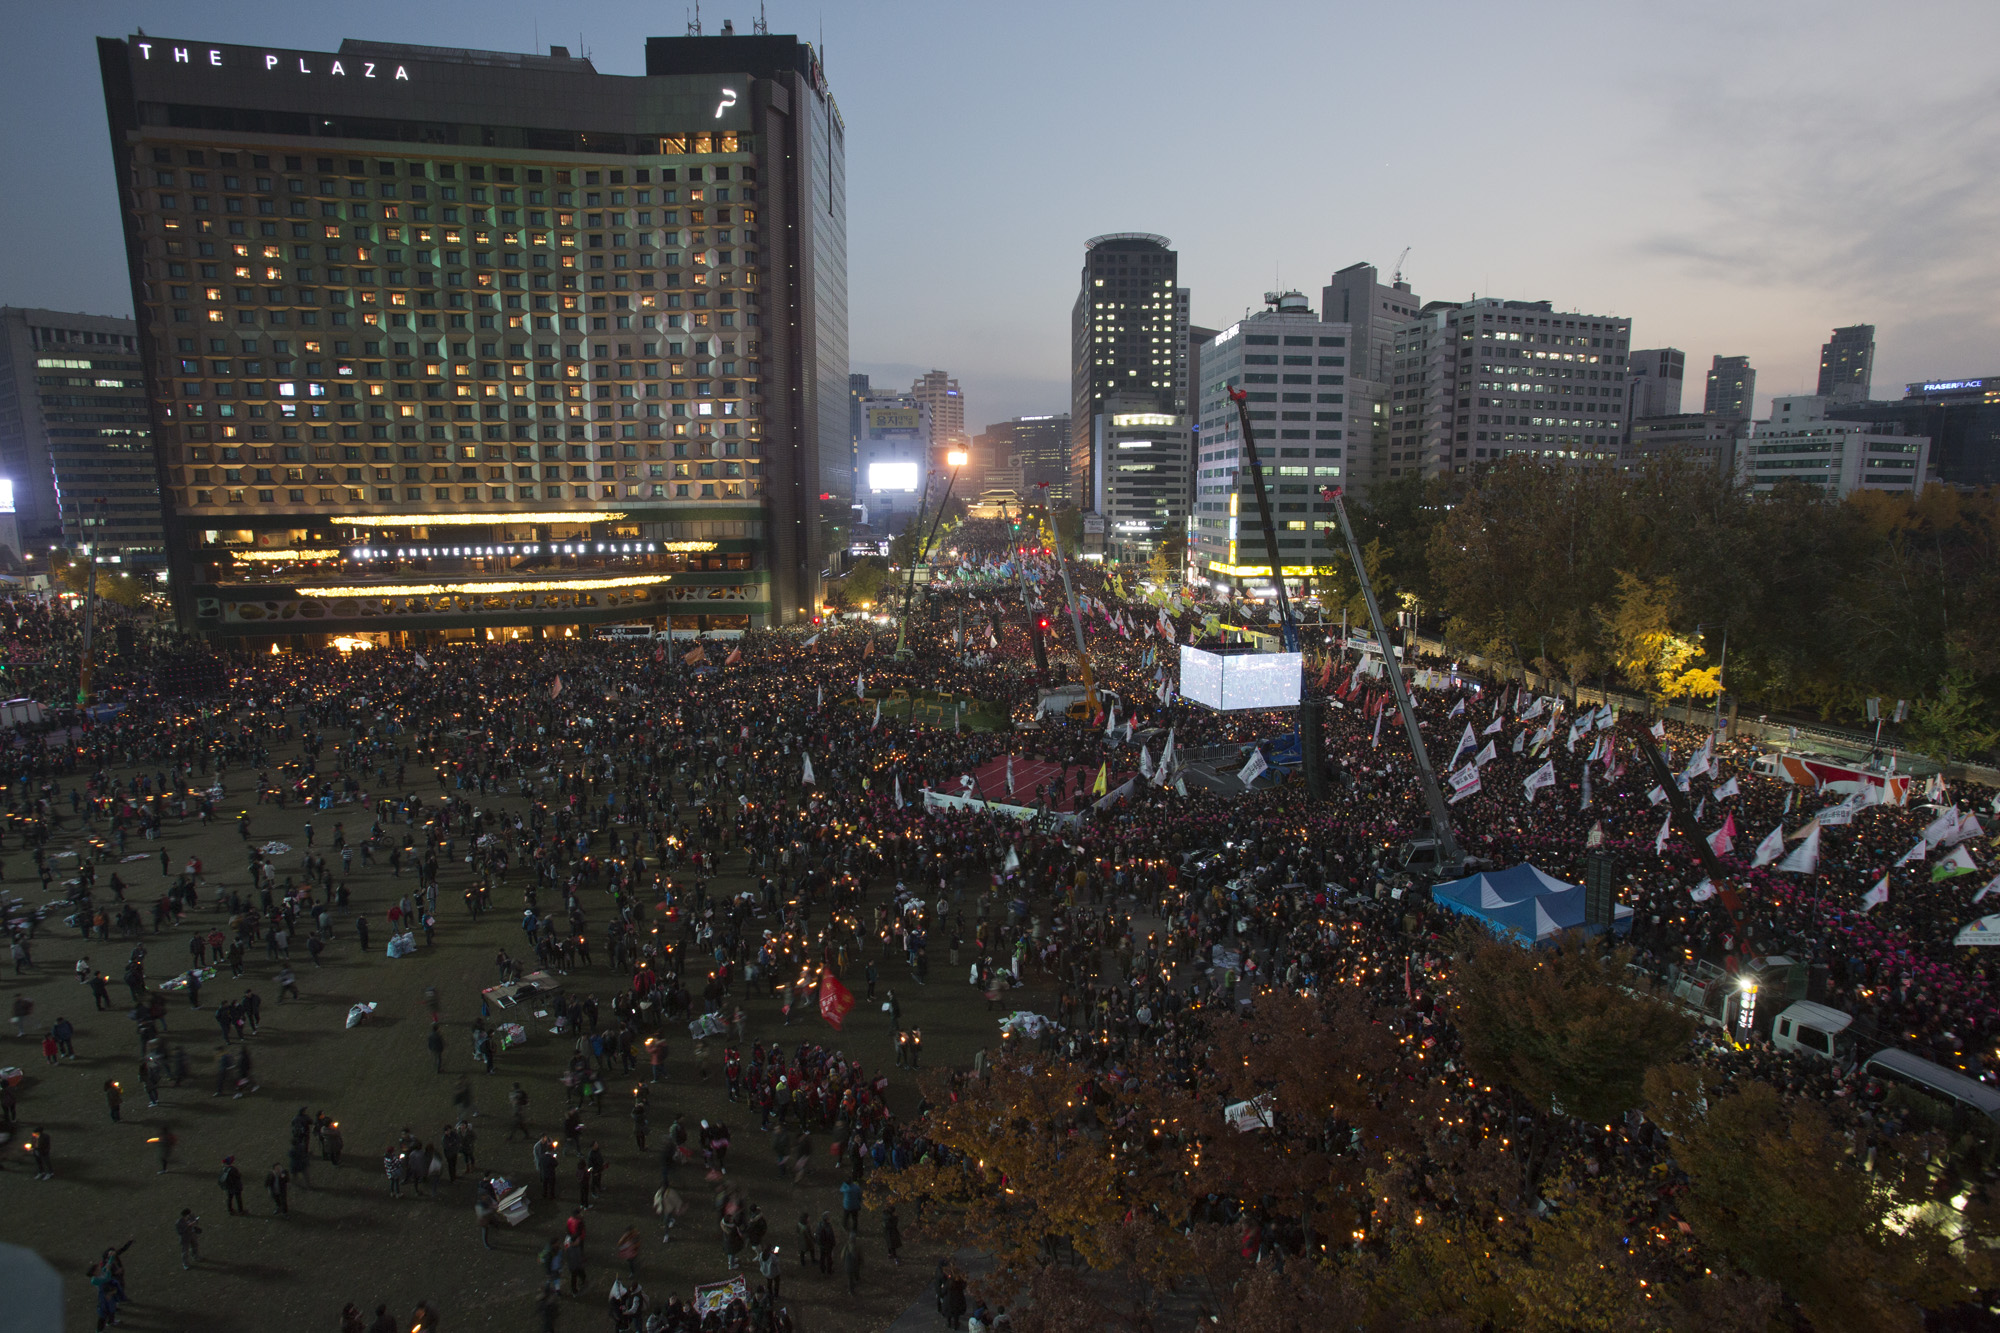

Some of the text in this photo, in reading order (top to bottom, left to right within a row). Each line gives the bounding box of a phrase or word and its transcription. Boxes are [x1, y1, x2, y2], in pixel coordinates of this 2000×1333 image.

[139, 44, 409, 81] THE PLAZA
[353, 543, 655, 558] 40th ANNIVERSARY OF THE PLAZA
